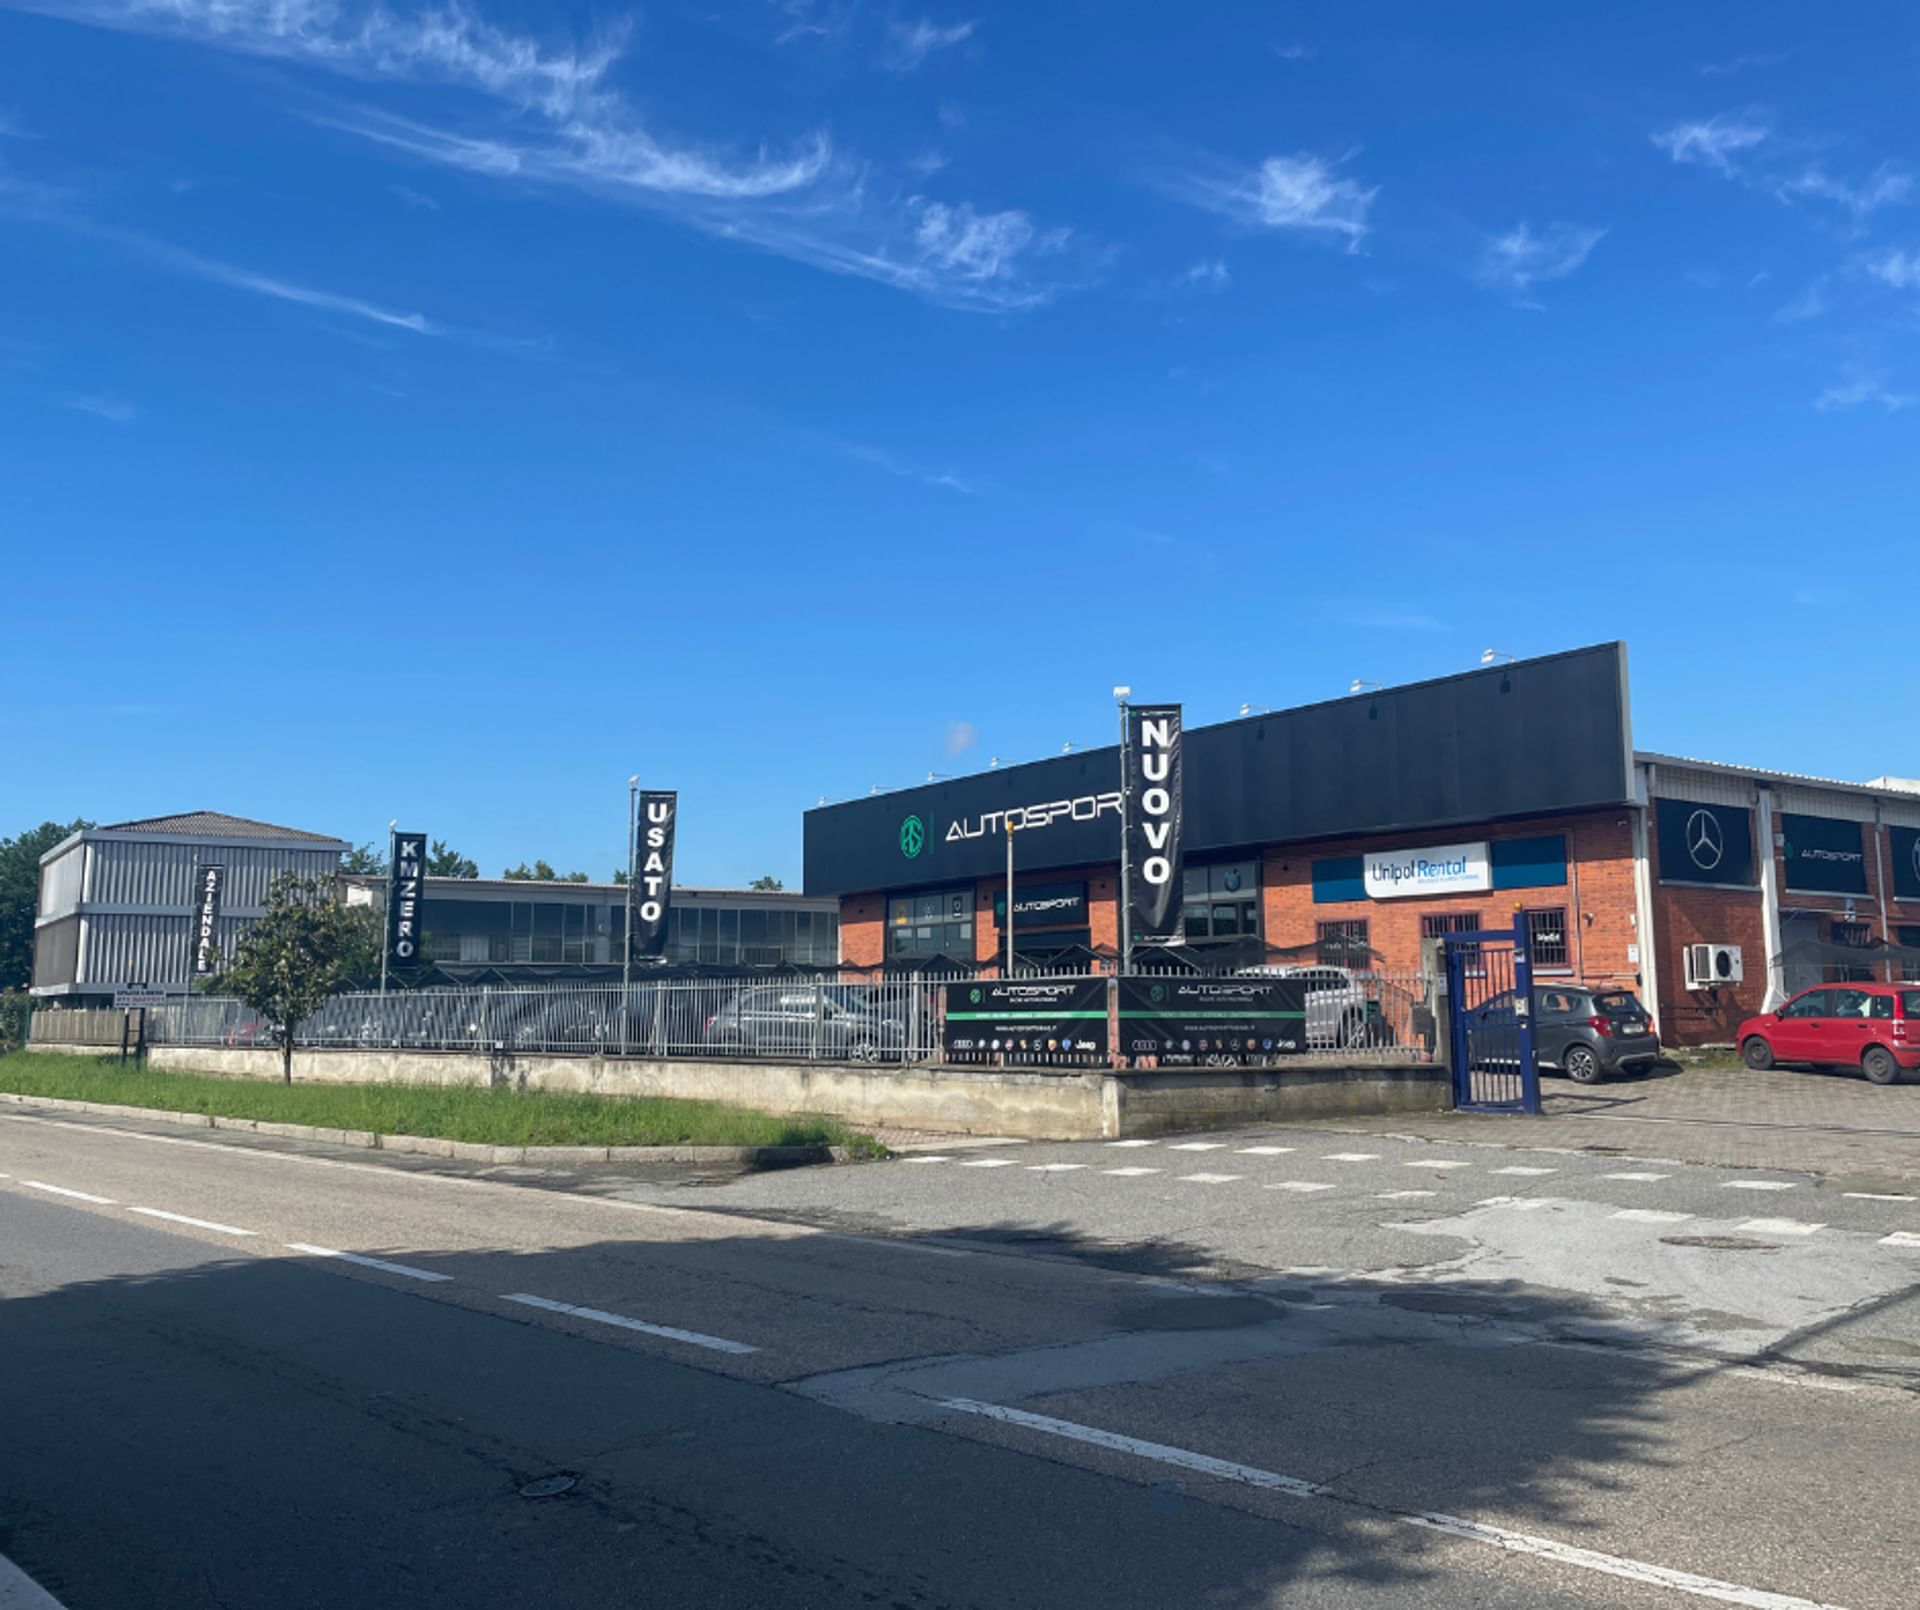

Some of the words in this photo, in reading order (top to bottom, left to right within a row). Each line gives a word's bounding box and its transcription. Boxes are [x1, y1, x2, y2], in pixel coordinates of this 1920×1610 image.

[945, 791, 1123, 841] AUTOSPOR
[1142, 719, 1171, 884] NUOVO
[640, 802, 668, 922] USATO
[1801, 849, 1861, 862] AUTOSPORT
[1372, 860, 1414, 885] Unipol
[1417, 856, 1466, 877] Rental
[1013, 896, 1080, 912] AUTOSPORT
[198, 870, 216, 971] AZIENDALE
[991, 985, 1076, 996] AUTOSPORT
[1178, 985, 1272, 994] AUTOSPORT
